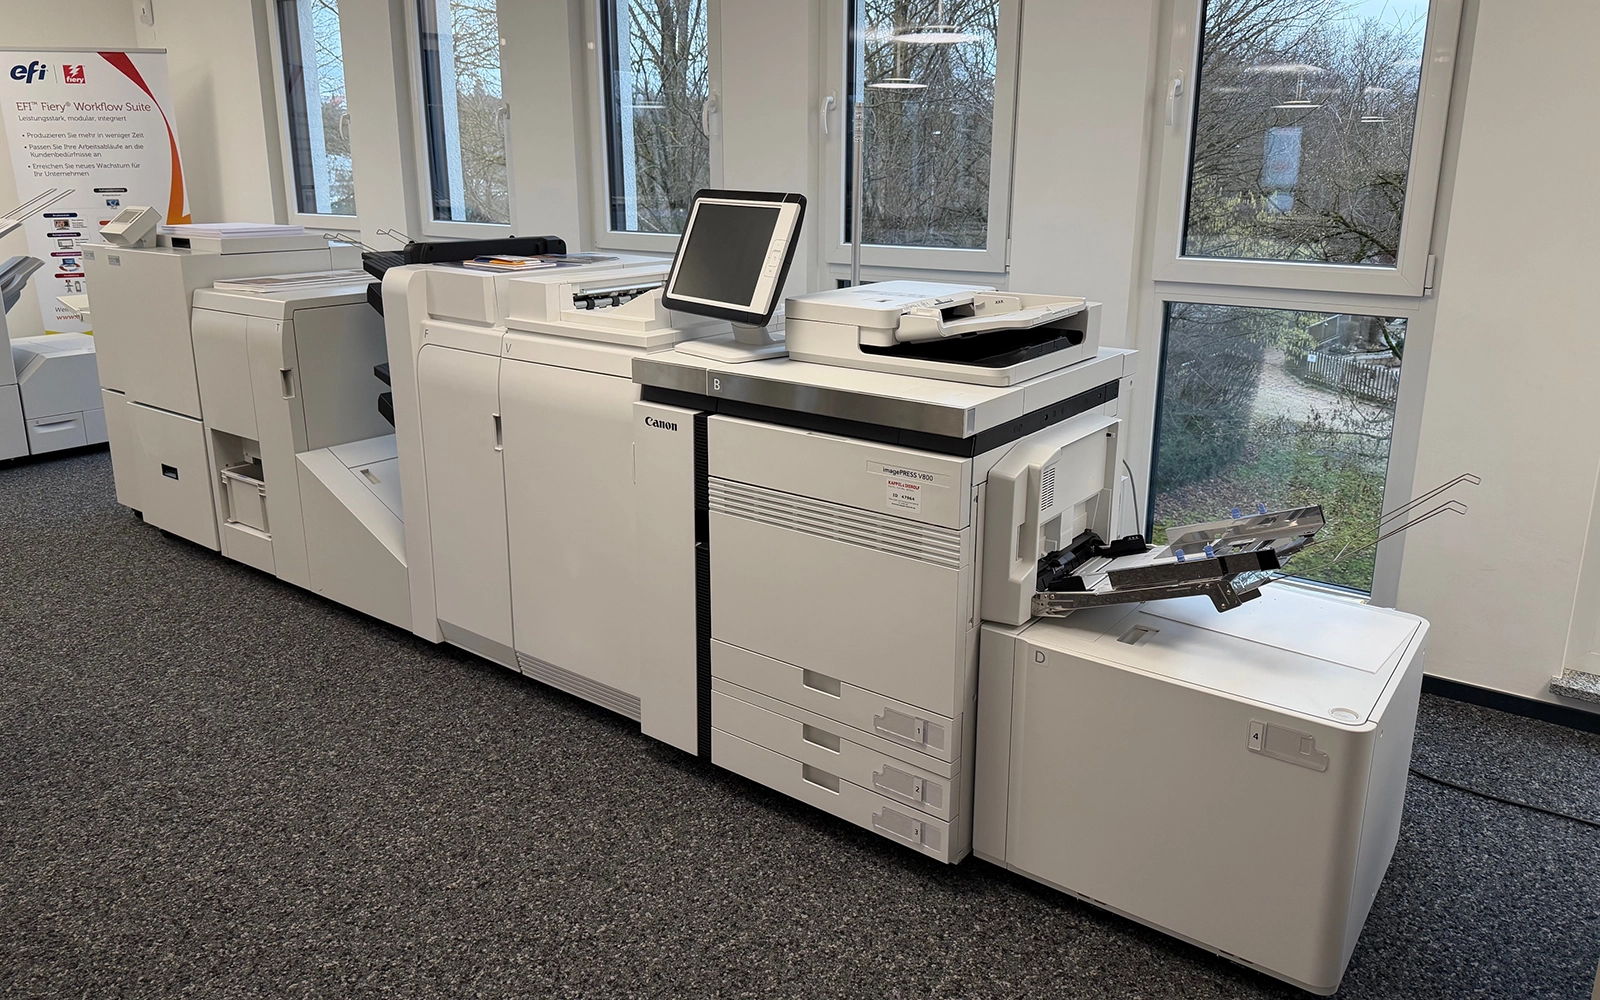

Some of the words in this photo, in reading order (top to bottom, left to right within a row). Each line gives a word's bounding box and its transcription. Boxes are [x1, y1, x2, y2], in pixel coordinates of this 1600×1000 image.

[10, 60, 47, 84] efi
[73, 102, 123, 111] Workflow
[125, 102, 151, 111] Suite
[105, 132, 131, 140] weniger
[505, 343, 512, 353] V
[713, 378, 721, 391] B
[645, 416, 678, 432] Canon
[883, 467, 917, 478] imagePRESS
[1035, 650, 1046, 663] D
[1252, 732, 1259, 740] 4
[915, 785, 920, 793] 2
